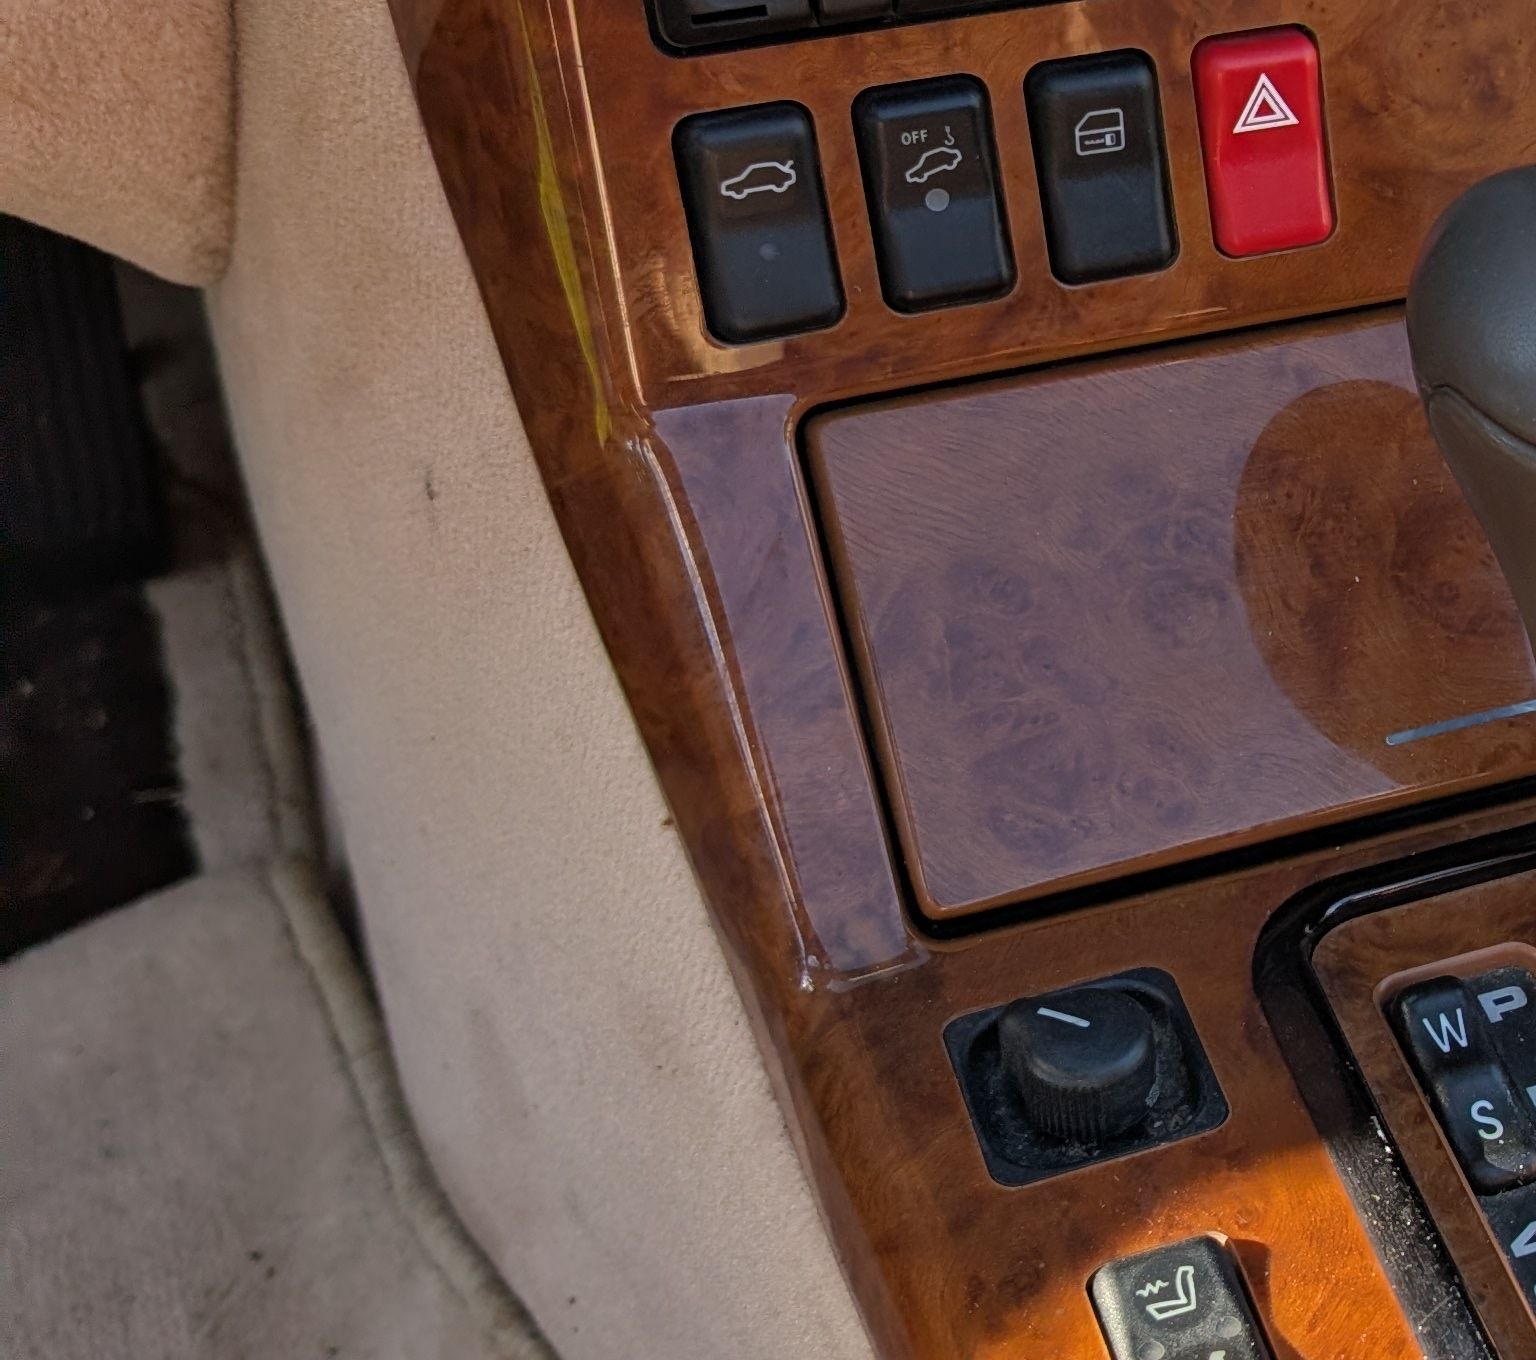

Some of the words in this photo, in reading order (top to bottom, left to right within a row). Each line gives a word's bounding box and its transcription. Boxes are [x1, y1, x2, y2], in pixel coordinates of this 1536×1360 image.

[902, 129, 927, 145] OFF
[1477, 985, 1528, 1024] P
[1422, 1007, 1469, 1053] W
[1470, 1099, 1504, 1140] S
